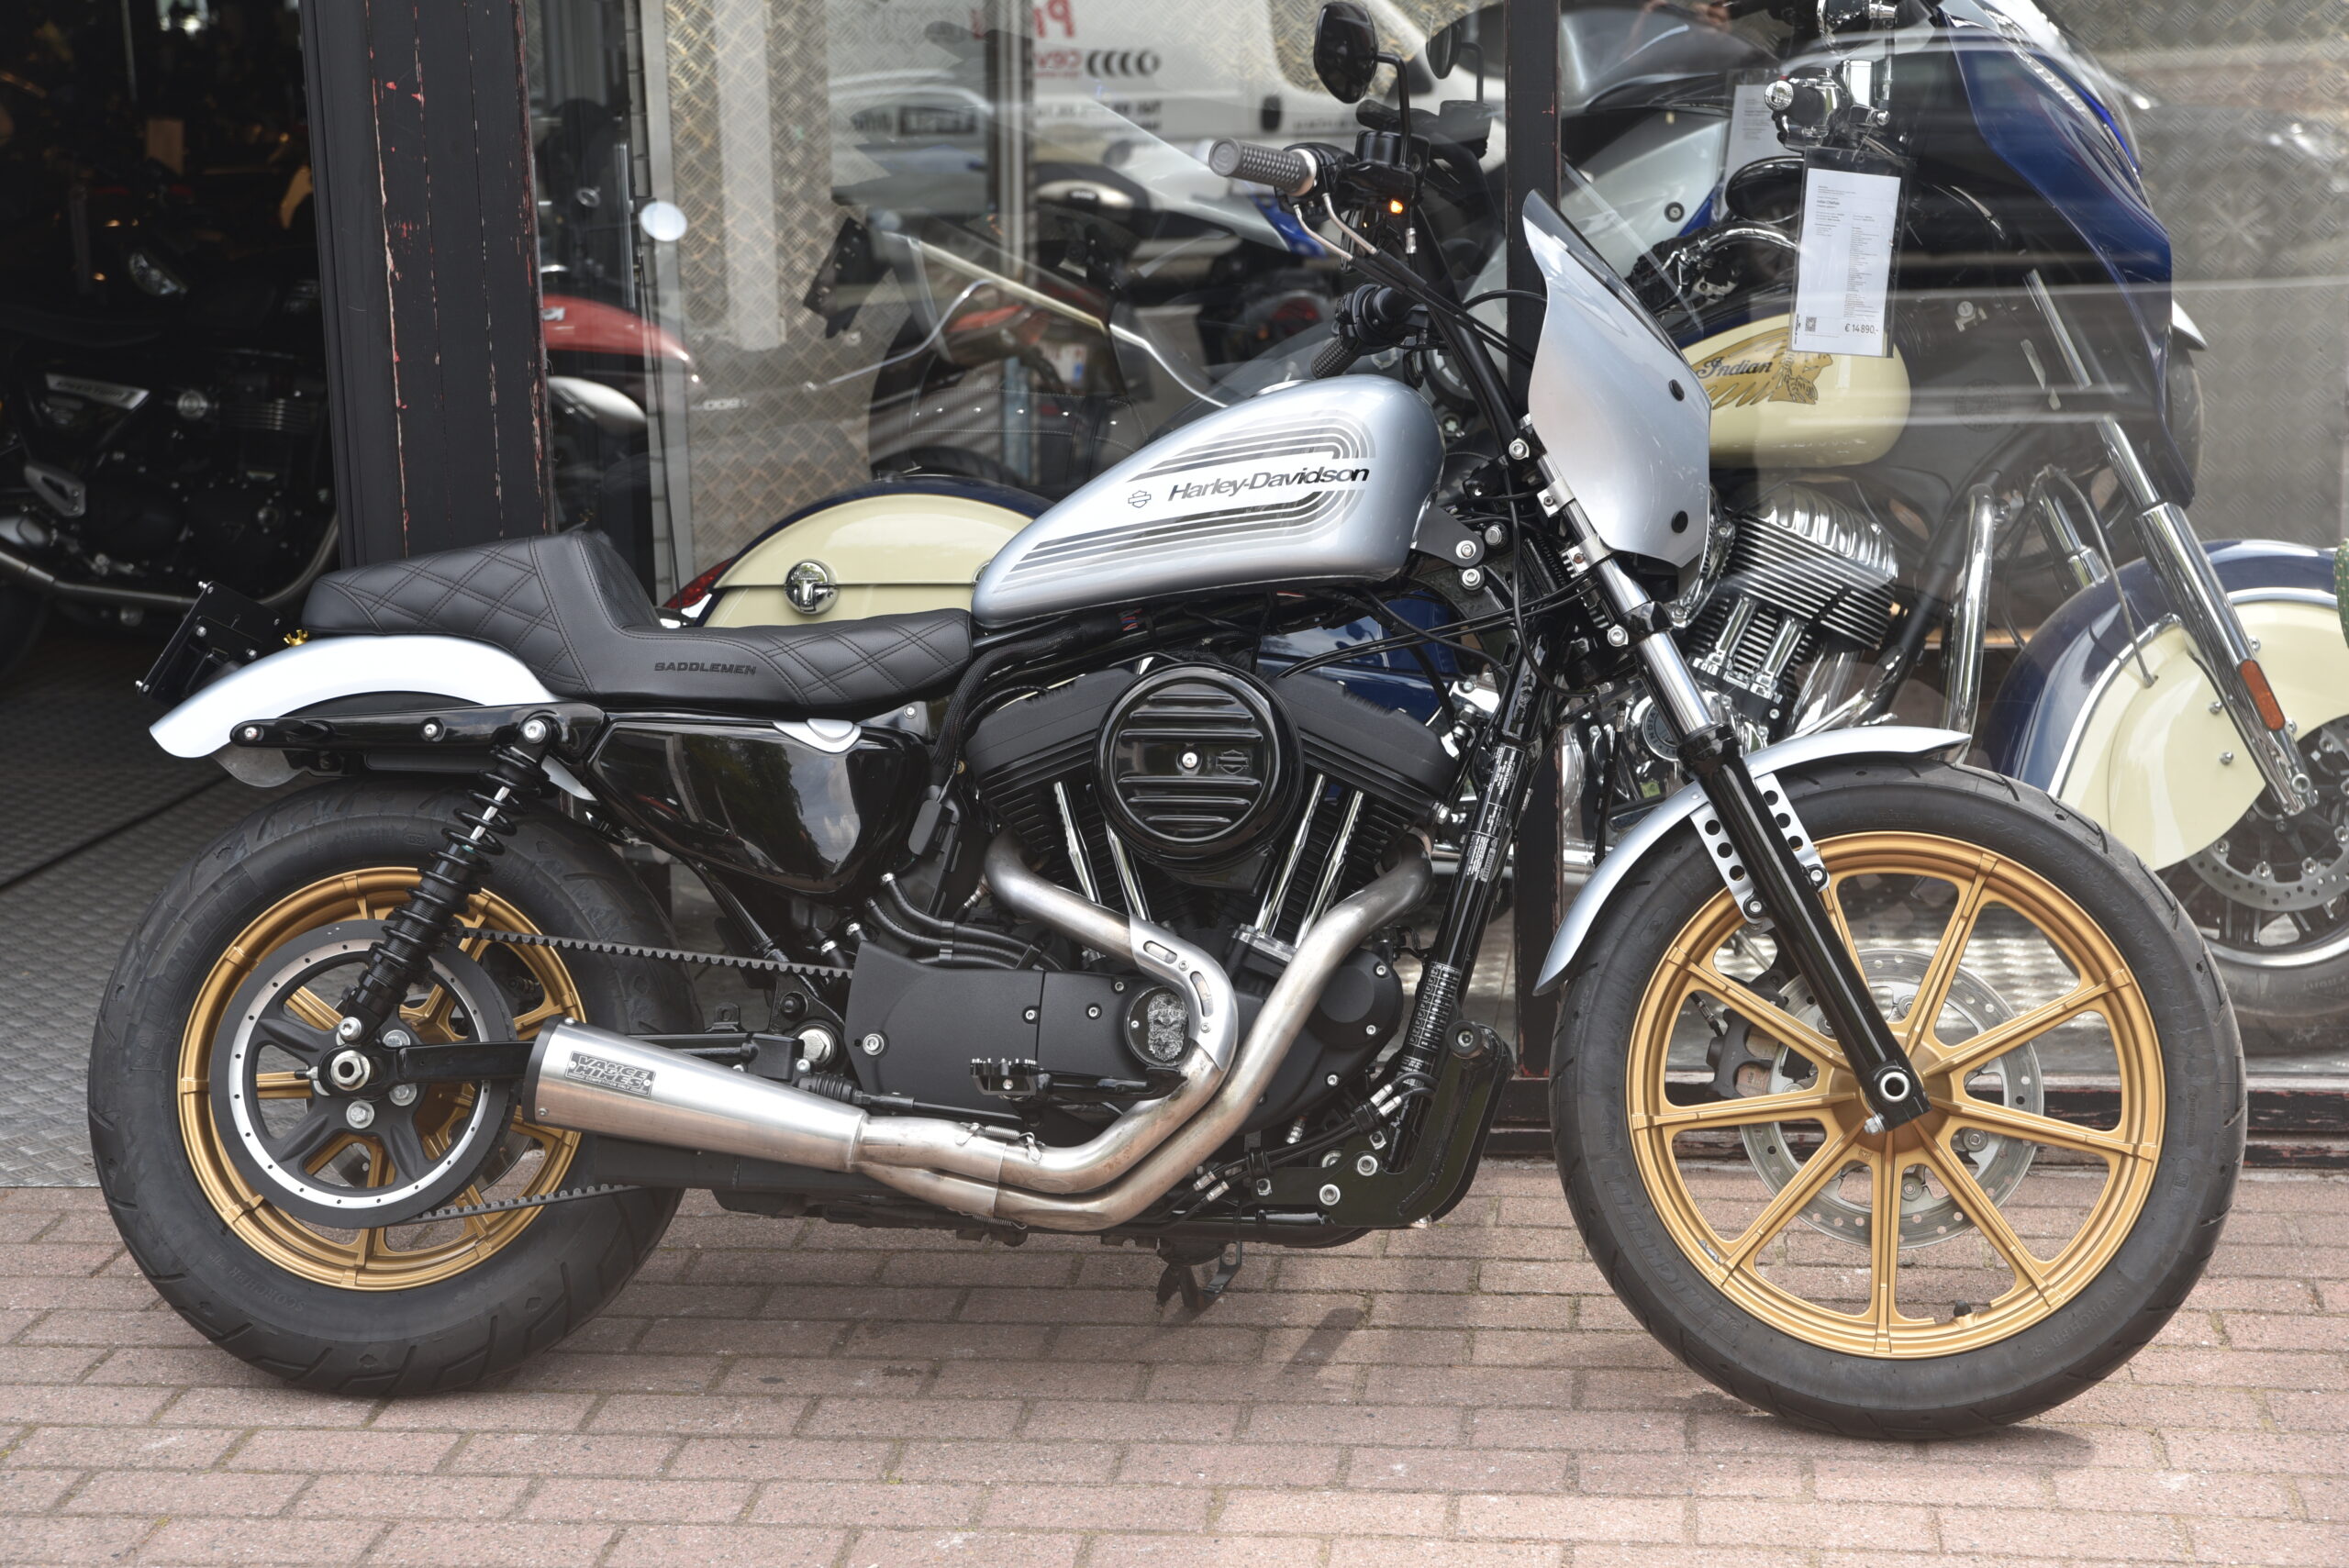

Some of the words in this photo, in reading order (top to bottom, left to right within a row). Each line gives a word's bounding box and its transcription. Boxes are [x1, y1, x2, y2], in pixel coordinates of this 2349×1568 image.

[1844, 323, 1851, 332] €
[1695, 356, 1774, 379] Indian
[1168, 466, 1370, 502] Harley-Davidson
[653, 662, 757, 676] SADDLEMEN
[573, 1064, 643, 1088] HINES
[578, 1055, 650, 1079] VANCE
[585, 1075, 618, 1088] COMPETITION
[226, 1259, 306, 1318] SCORCHER
[2046, 1275, 2130, 1352] SCORCHER
